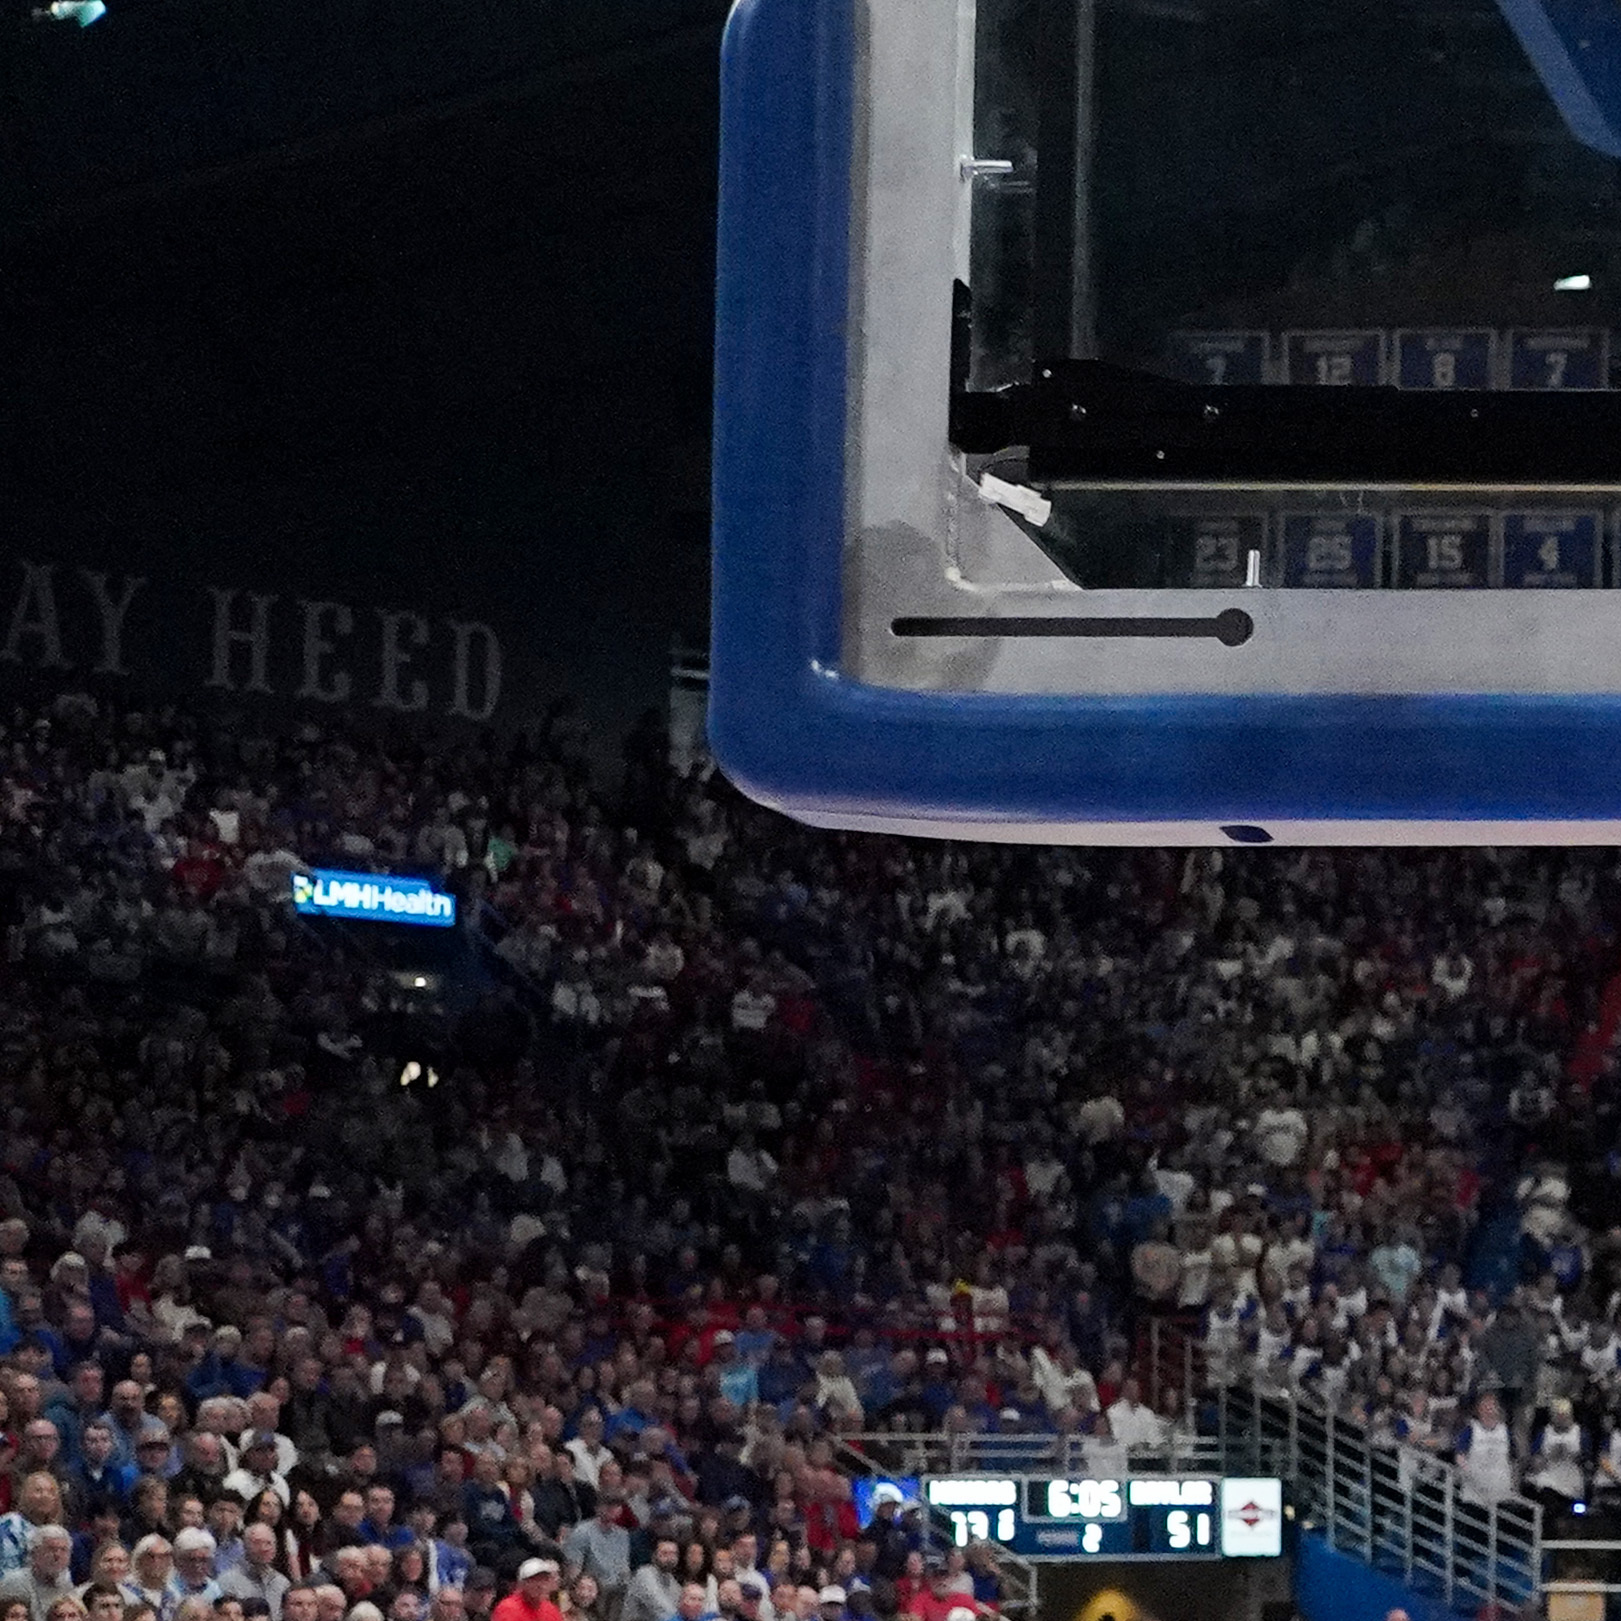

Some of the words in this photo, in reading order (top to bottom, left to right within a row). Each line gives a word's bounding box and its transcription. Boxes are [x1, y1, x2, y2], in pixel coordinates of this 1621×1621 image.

[0, 560, 149, 678] AY
[203, 583, 504, 723] HEED
[1048, 1479, 1121, 1518] 6:05
